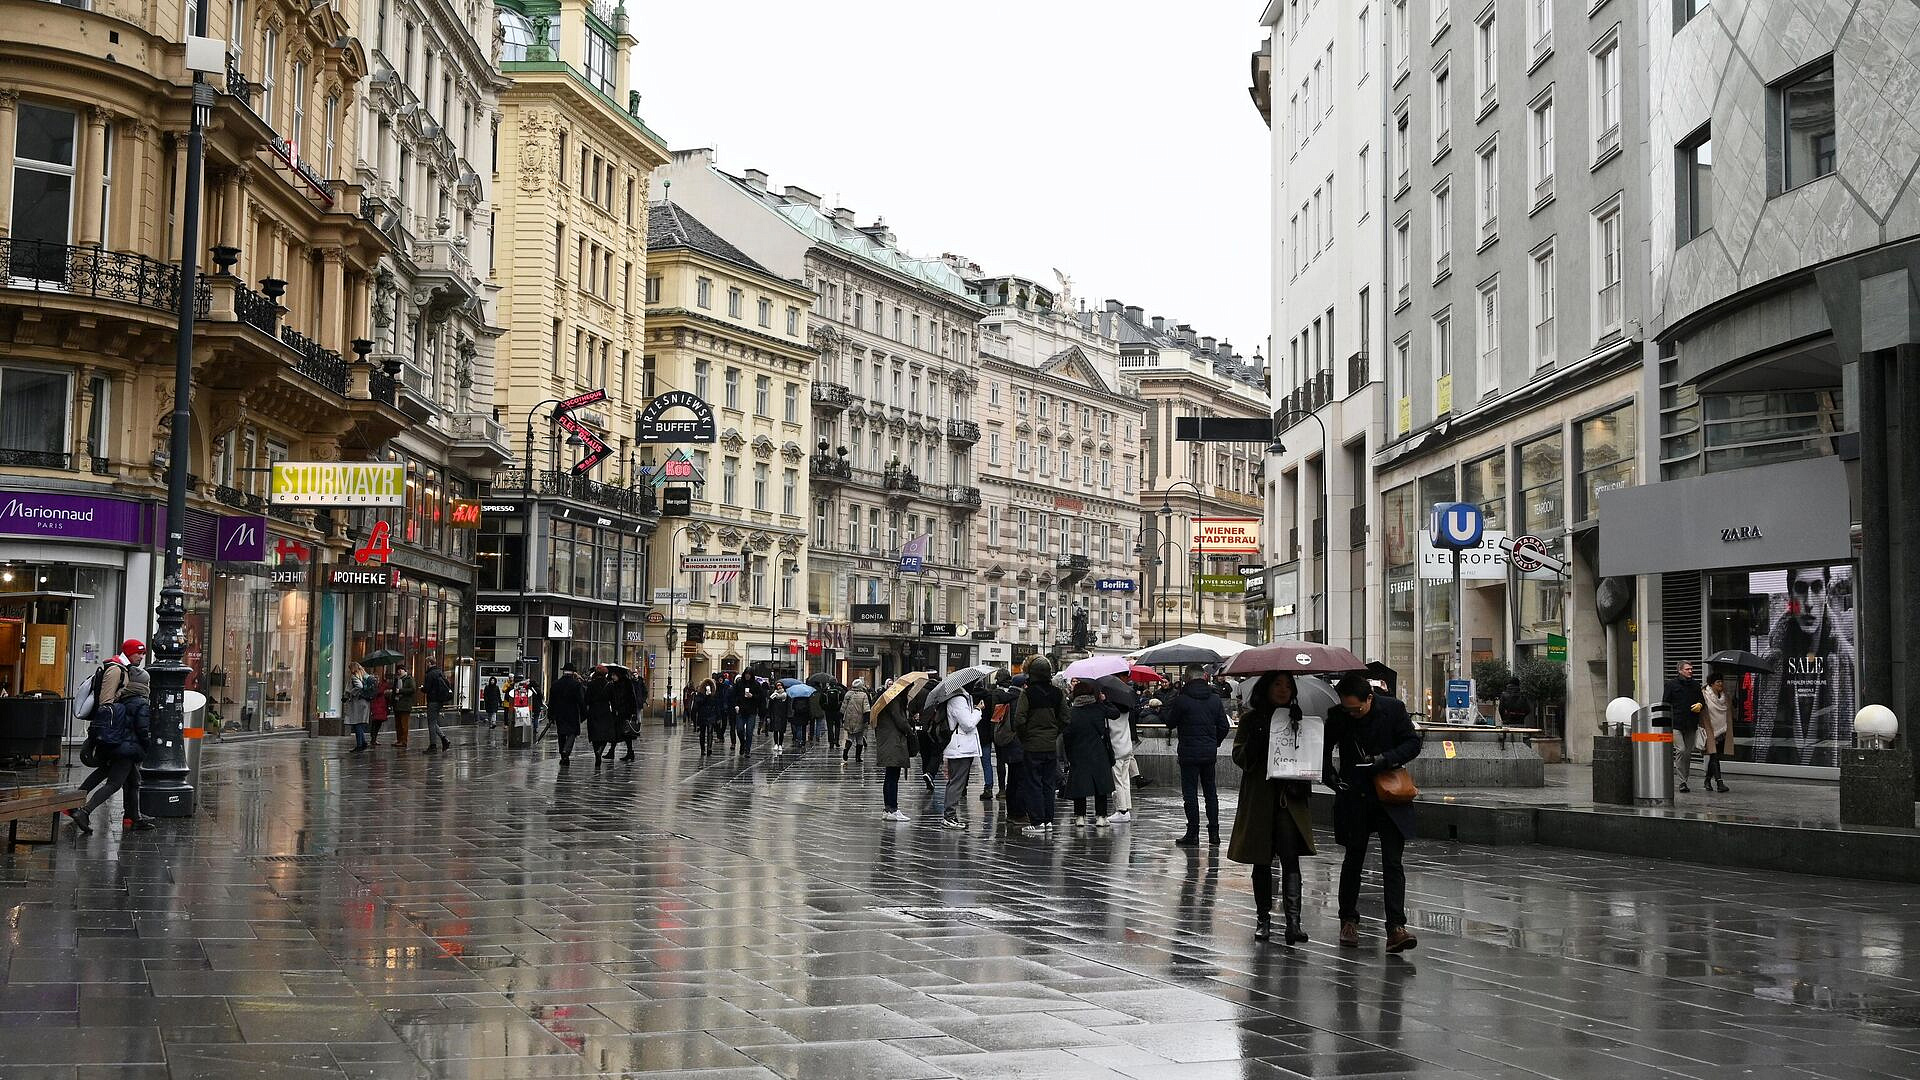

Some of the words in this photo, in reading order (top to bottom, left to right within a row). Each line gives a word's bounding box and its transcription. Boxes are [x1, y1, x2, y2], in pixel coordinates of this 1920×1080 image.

[655, 422, 698, 432] BUFFET
[665, 460, 691, 476] Köö
[280, 465, 396, 496] STURMAYR
[279, 495, 395, 503] COIFFEURE
[0, 498, 94, 521] Marionnaud
[452, 504, 480, 523] H&M
[37, 521, 63, 530] PARIS
[1204, 527, 1245, 535] WIENER
[1448, 511, 1476, 541] U
[1720, 525, 1763, 542] ZARA
[223, 521, 256, 552] M
[1193, 535, 1256, 544] STADTBRÄU
[333, 571, 387, 585] APOTHEKE
[1102, 581, 1130, 589] Berlitz
[1788, 656, 1824, 674] SALE
